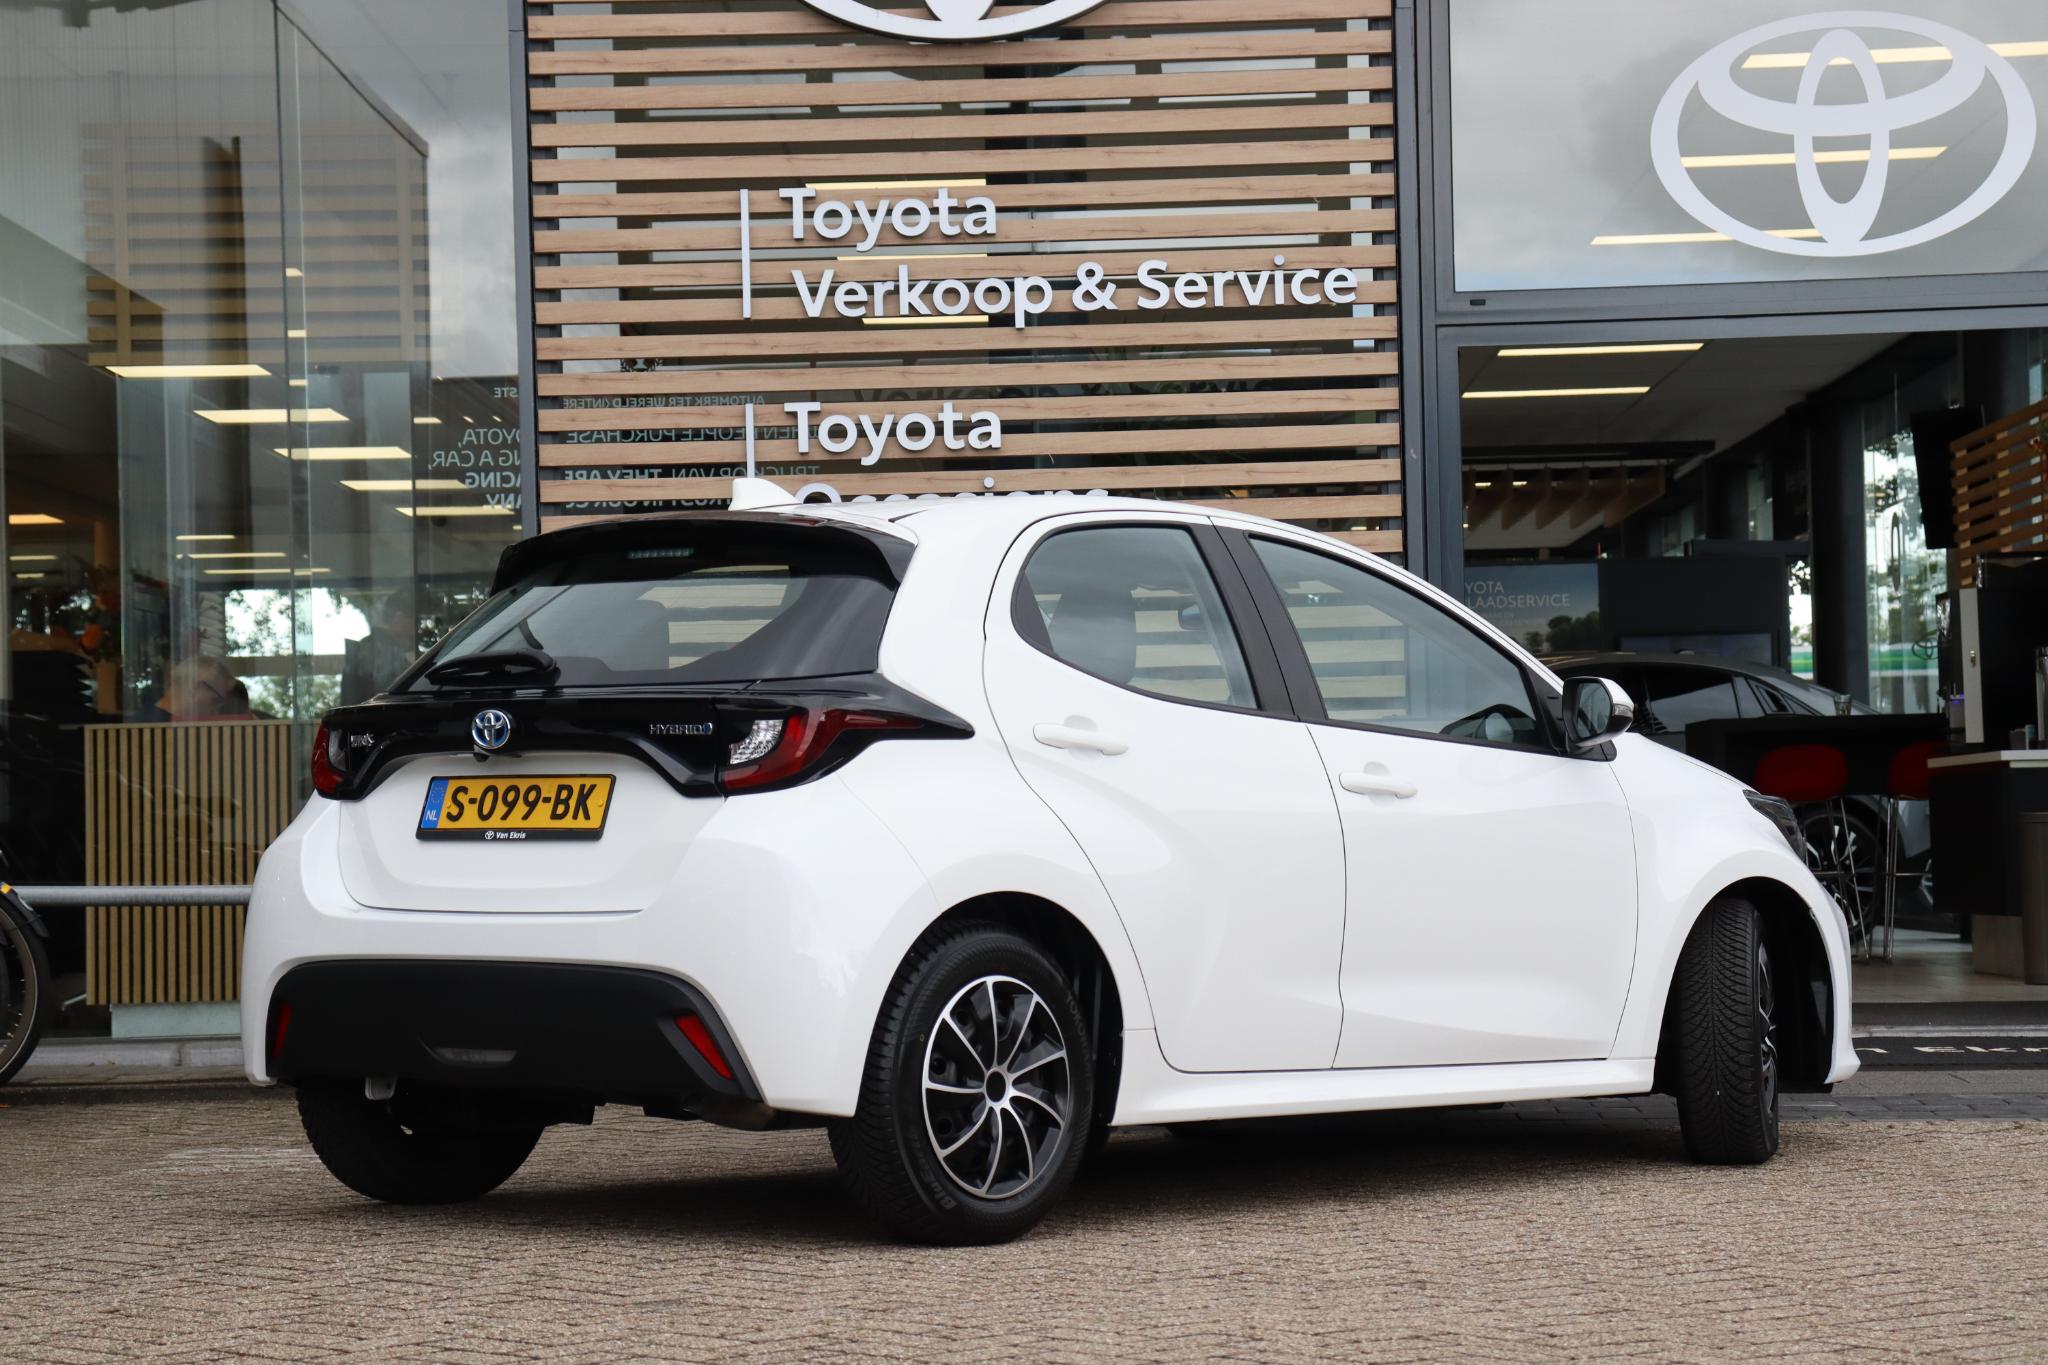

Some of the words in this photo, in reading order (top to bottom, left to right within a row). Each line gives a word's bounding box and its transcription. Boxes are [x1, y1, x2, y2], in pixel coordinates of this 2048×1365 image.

[779, 187, 998, 252] Toyota
[791, 264, 1054, 329] Verkoop
[1072, 261, 1119, 311] &
[1137, 254, 1358, 310] Service
[784, 401, 1002, 466] Toyota
[425, 810, 438, 821] NL
[446, 783, 597, 823] S-099-BK
[496, 831, 509, 839] Van
